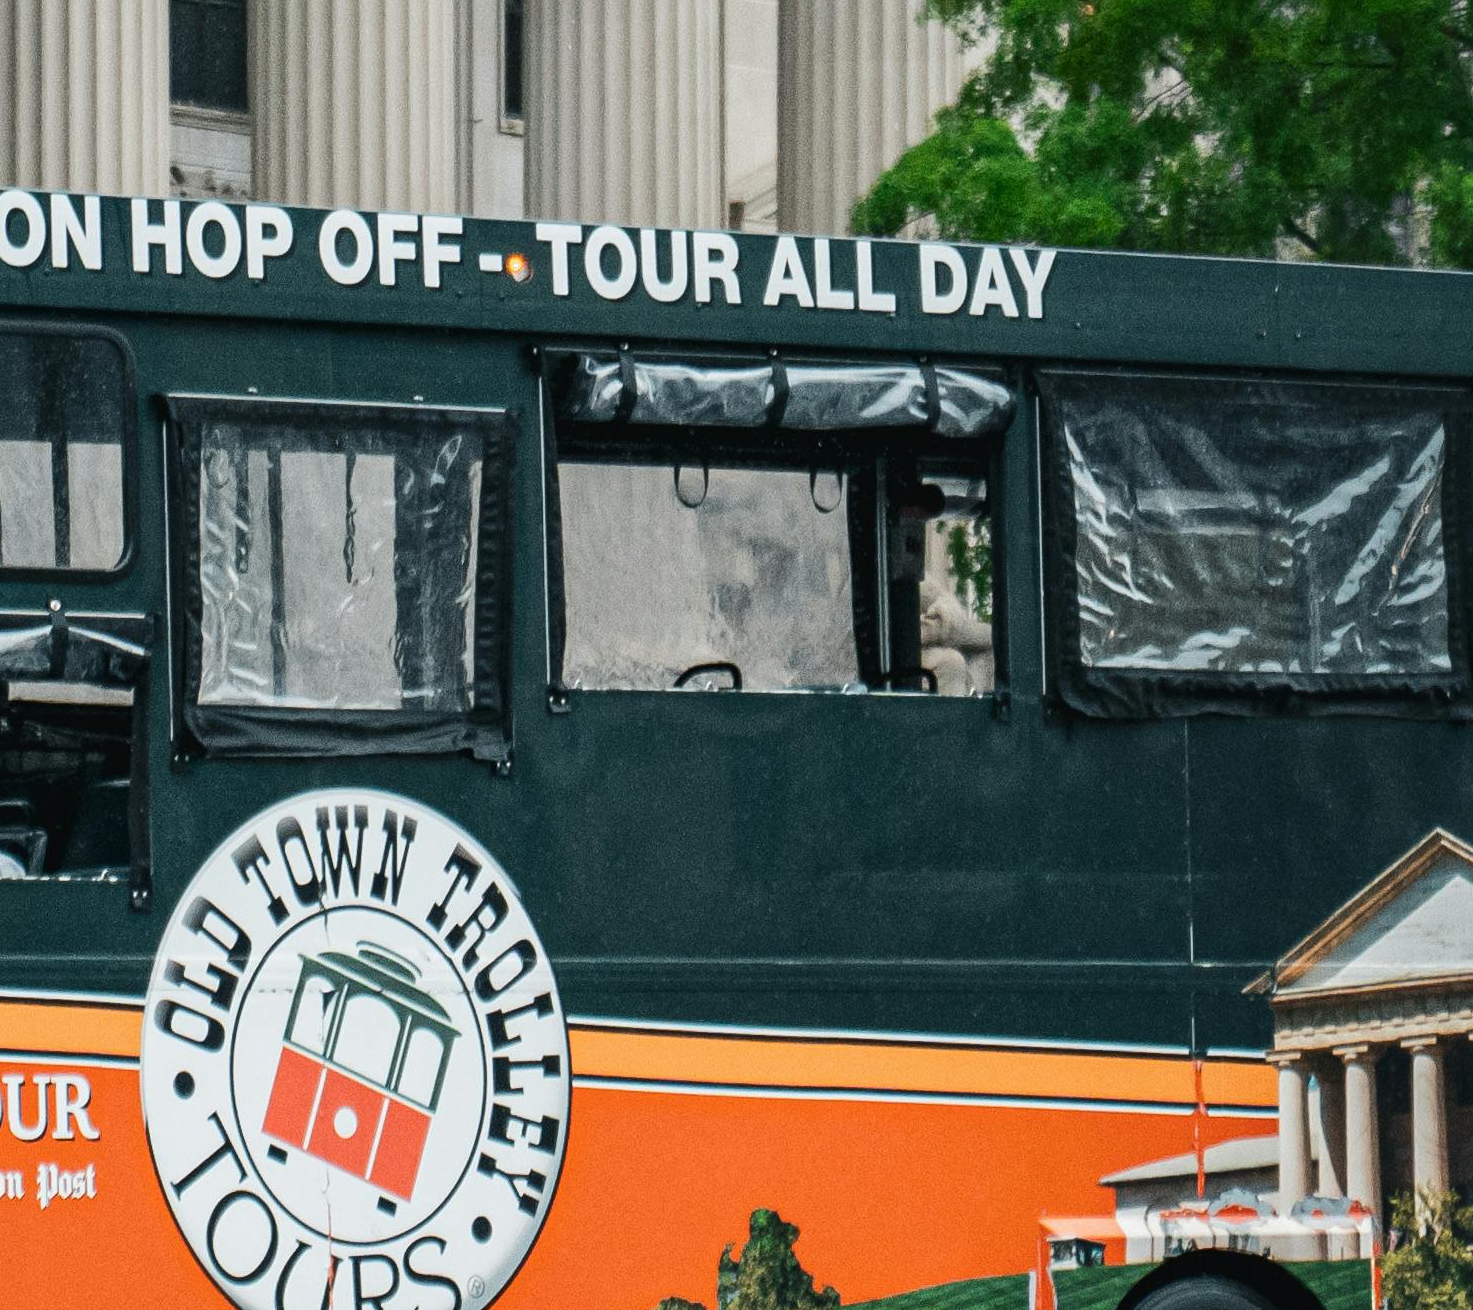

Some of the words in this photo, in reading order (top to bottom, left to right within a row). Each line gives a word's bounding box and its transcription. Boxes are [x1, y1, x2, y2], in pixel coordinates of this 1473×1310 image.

[131, 196, 294, 279] HOP
[318, 208, 463, 289] OFF
[535, 222, 743, 305] TOUR
[763, 236, 897, 312] ALL
[918, 243, 1057, 320] DAY
[153, 893, 255, 1053] OLD
[231, 803, 419, 926] TOWN
[425, 841, 562, 1218] TROLLEY
[36, 1162, 97, 1210] Post
